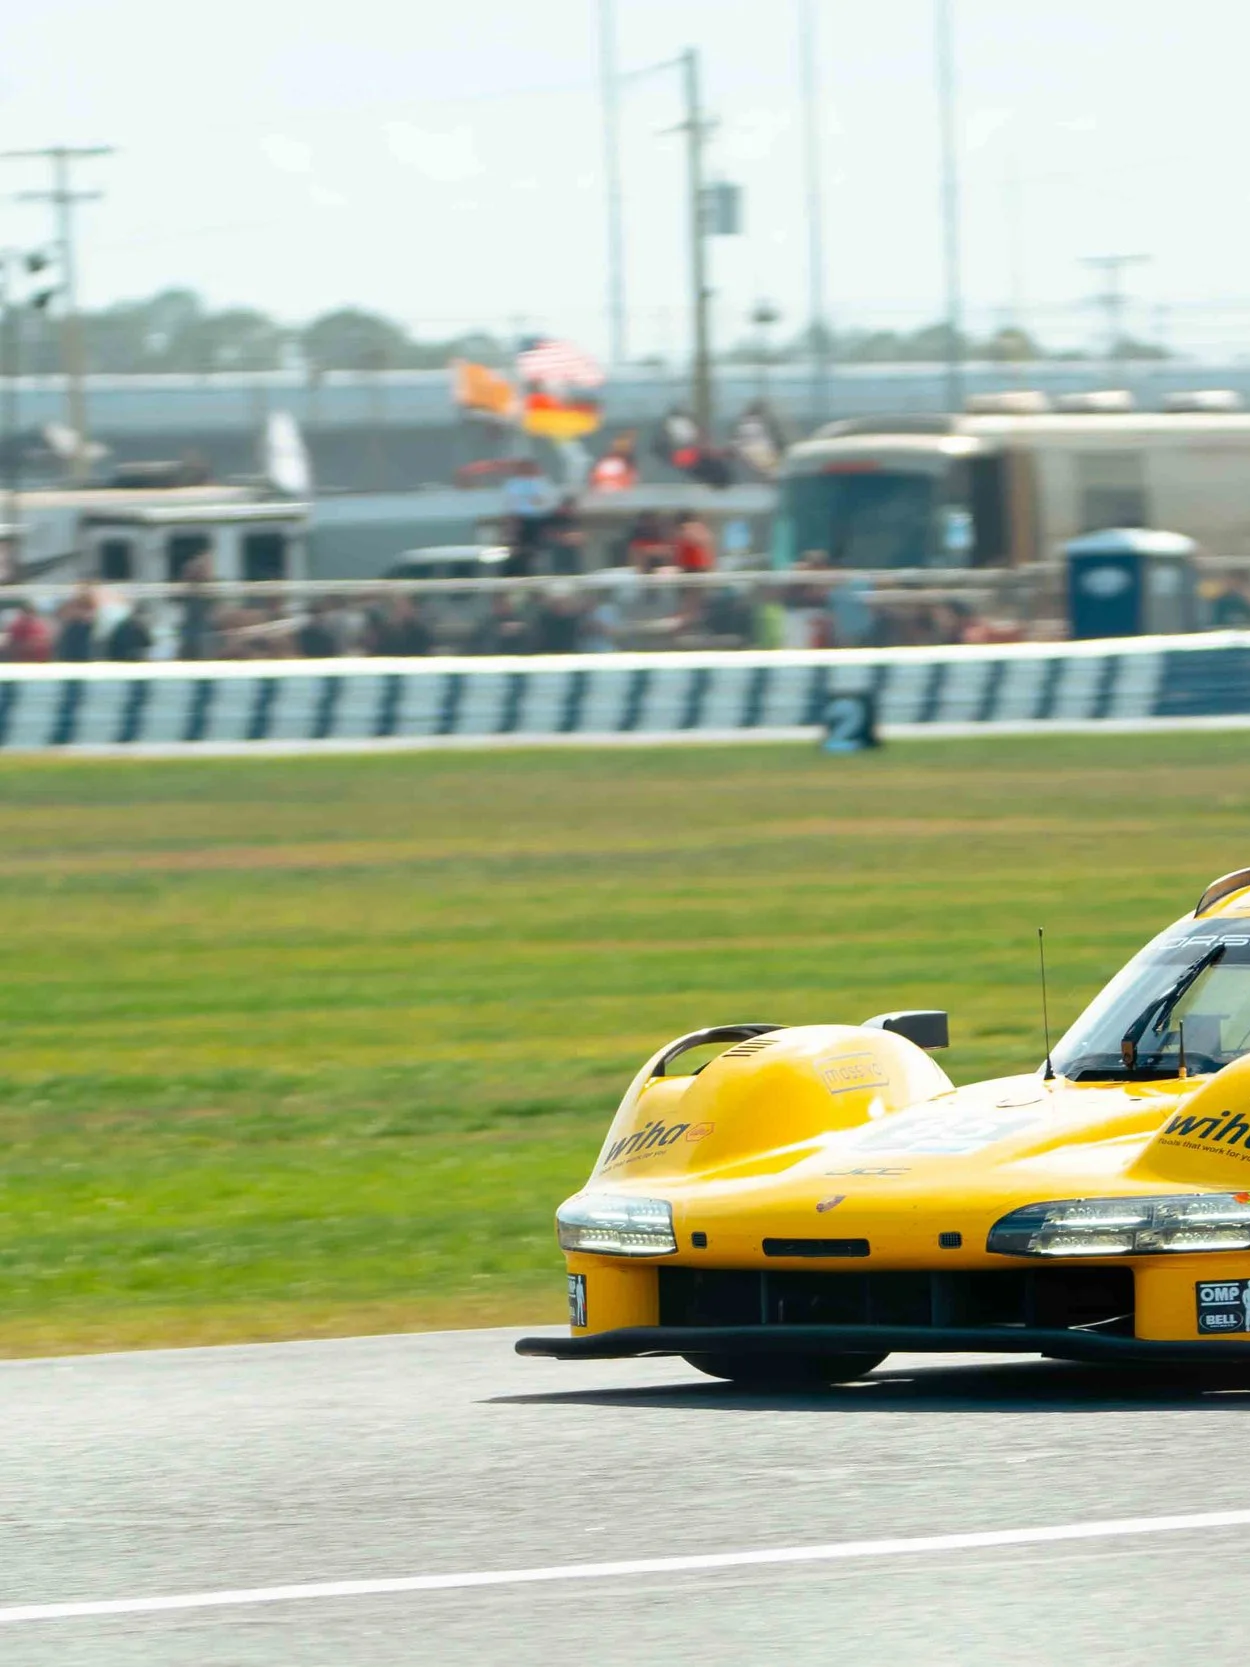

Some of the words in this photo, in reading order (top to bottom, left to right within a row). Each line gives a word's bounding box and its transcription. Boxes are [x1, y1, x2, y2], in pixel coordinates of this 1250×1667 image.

[822, 698, 866, 754] 2
[604, 1120, 690, 1165] wiha
[1182, 1140, 1201, 1150] that
[1202, 1144, 1225, 1155] work
[1225, 1148, 1241, 1159] for
[1200, 1286, 1240, 1302] OMP
[1205, 1314, 1238, 1326] BELL
